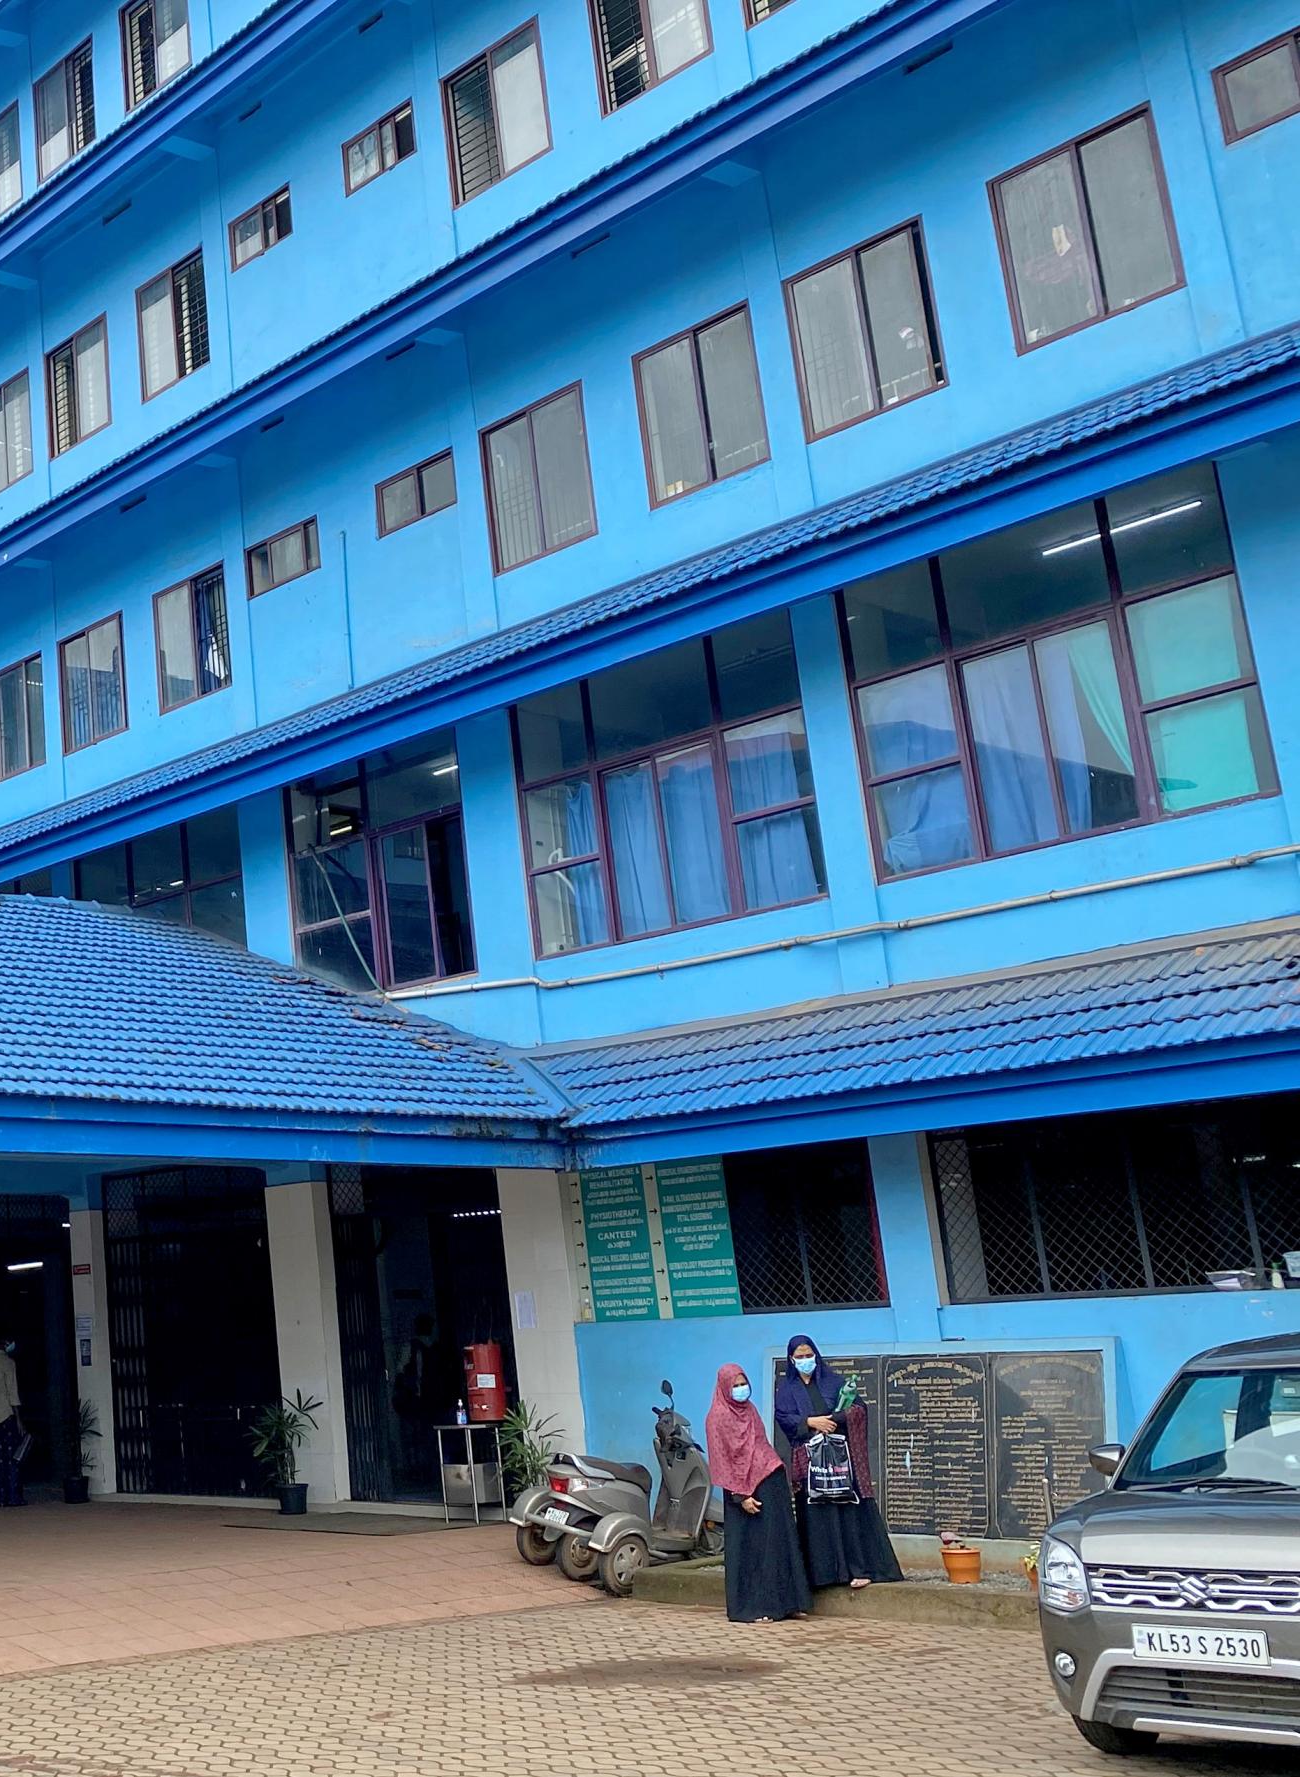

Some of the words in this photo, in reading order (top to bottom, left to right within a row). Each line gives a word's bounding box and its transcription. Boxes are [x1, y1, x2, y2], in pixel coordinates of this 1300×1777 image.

[590, 1208, 639, 1221] PHYSIOTHERAPY
[598, 1230, 637, 1241] CANTEEN
[624, 1297, 655, 1307] PHARMACY
[1146, 1632, 1192, 1655] KL53
[1197, 1635, 1208, 1656] S
[1214, 1636, 1262, 1659] 2530
